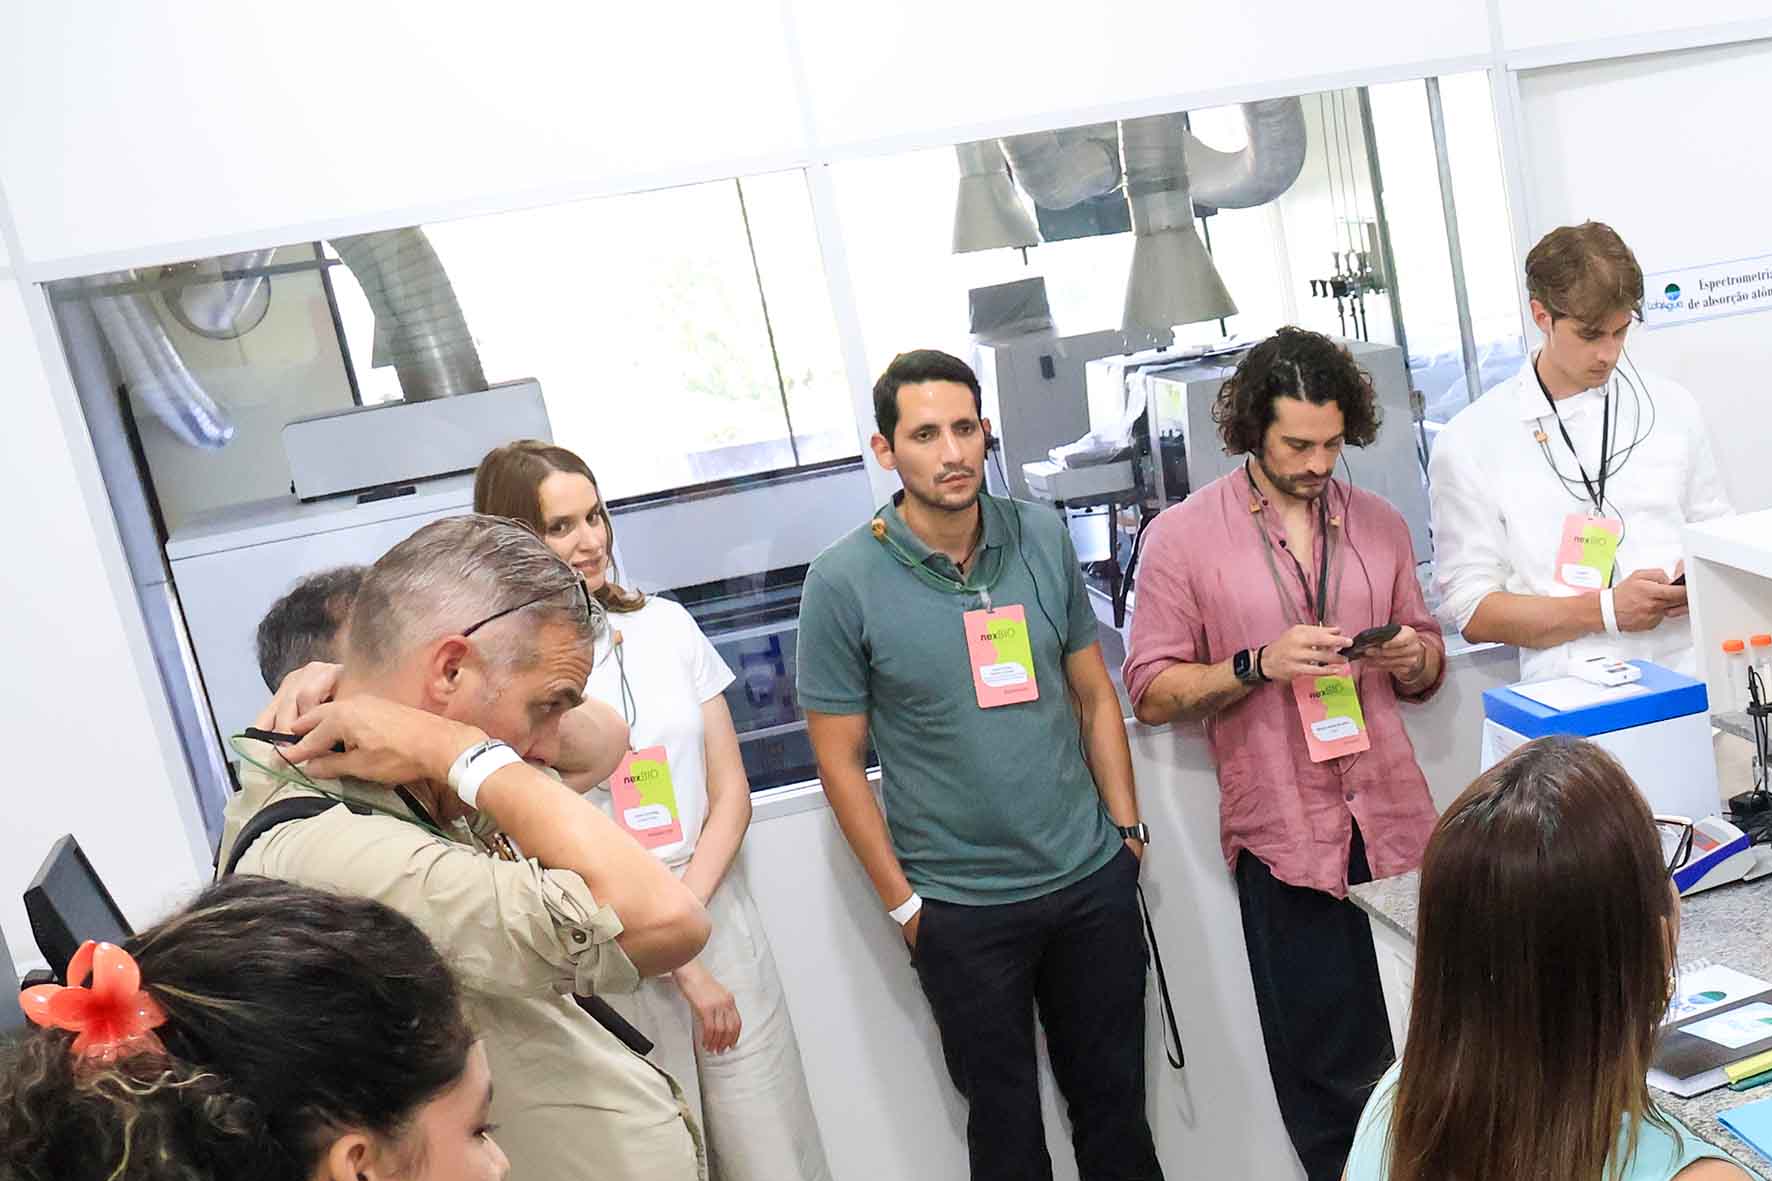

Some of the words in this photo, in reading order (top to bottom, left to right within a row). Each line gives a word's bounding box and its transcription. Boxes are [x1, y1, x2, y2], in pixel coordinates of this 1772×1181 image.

[1687, 298, 1700, 310] de
[1703, 292, 1749, 309] absorção
[980, 627, 1016, 641] nexBIO
